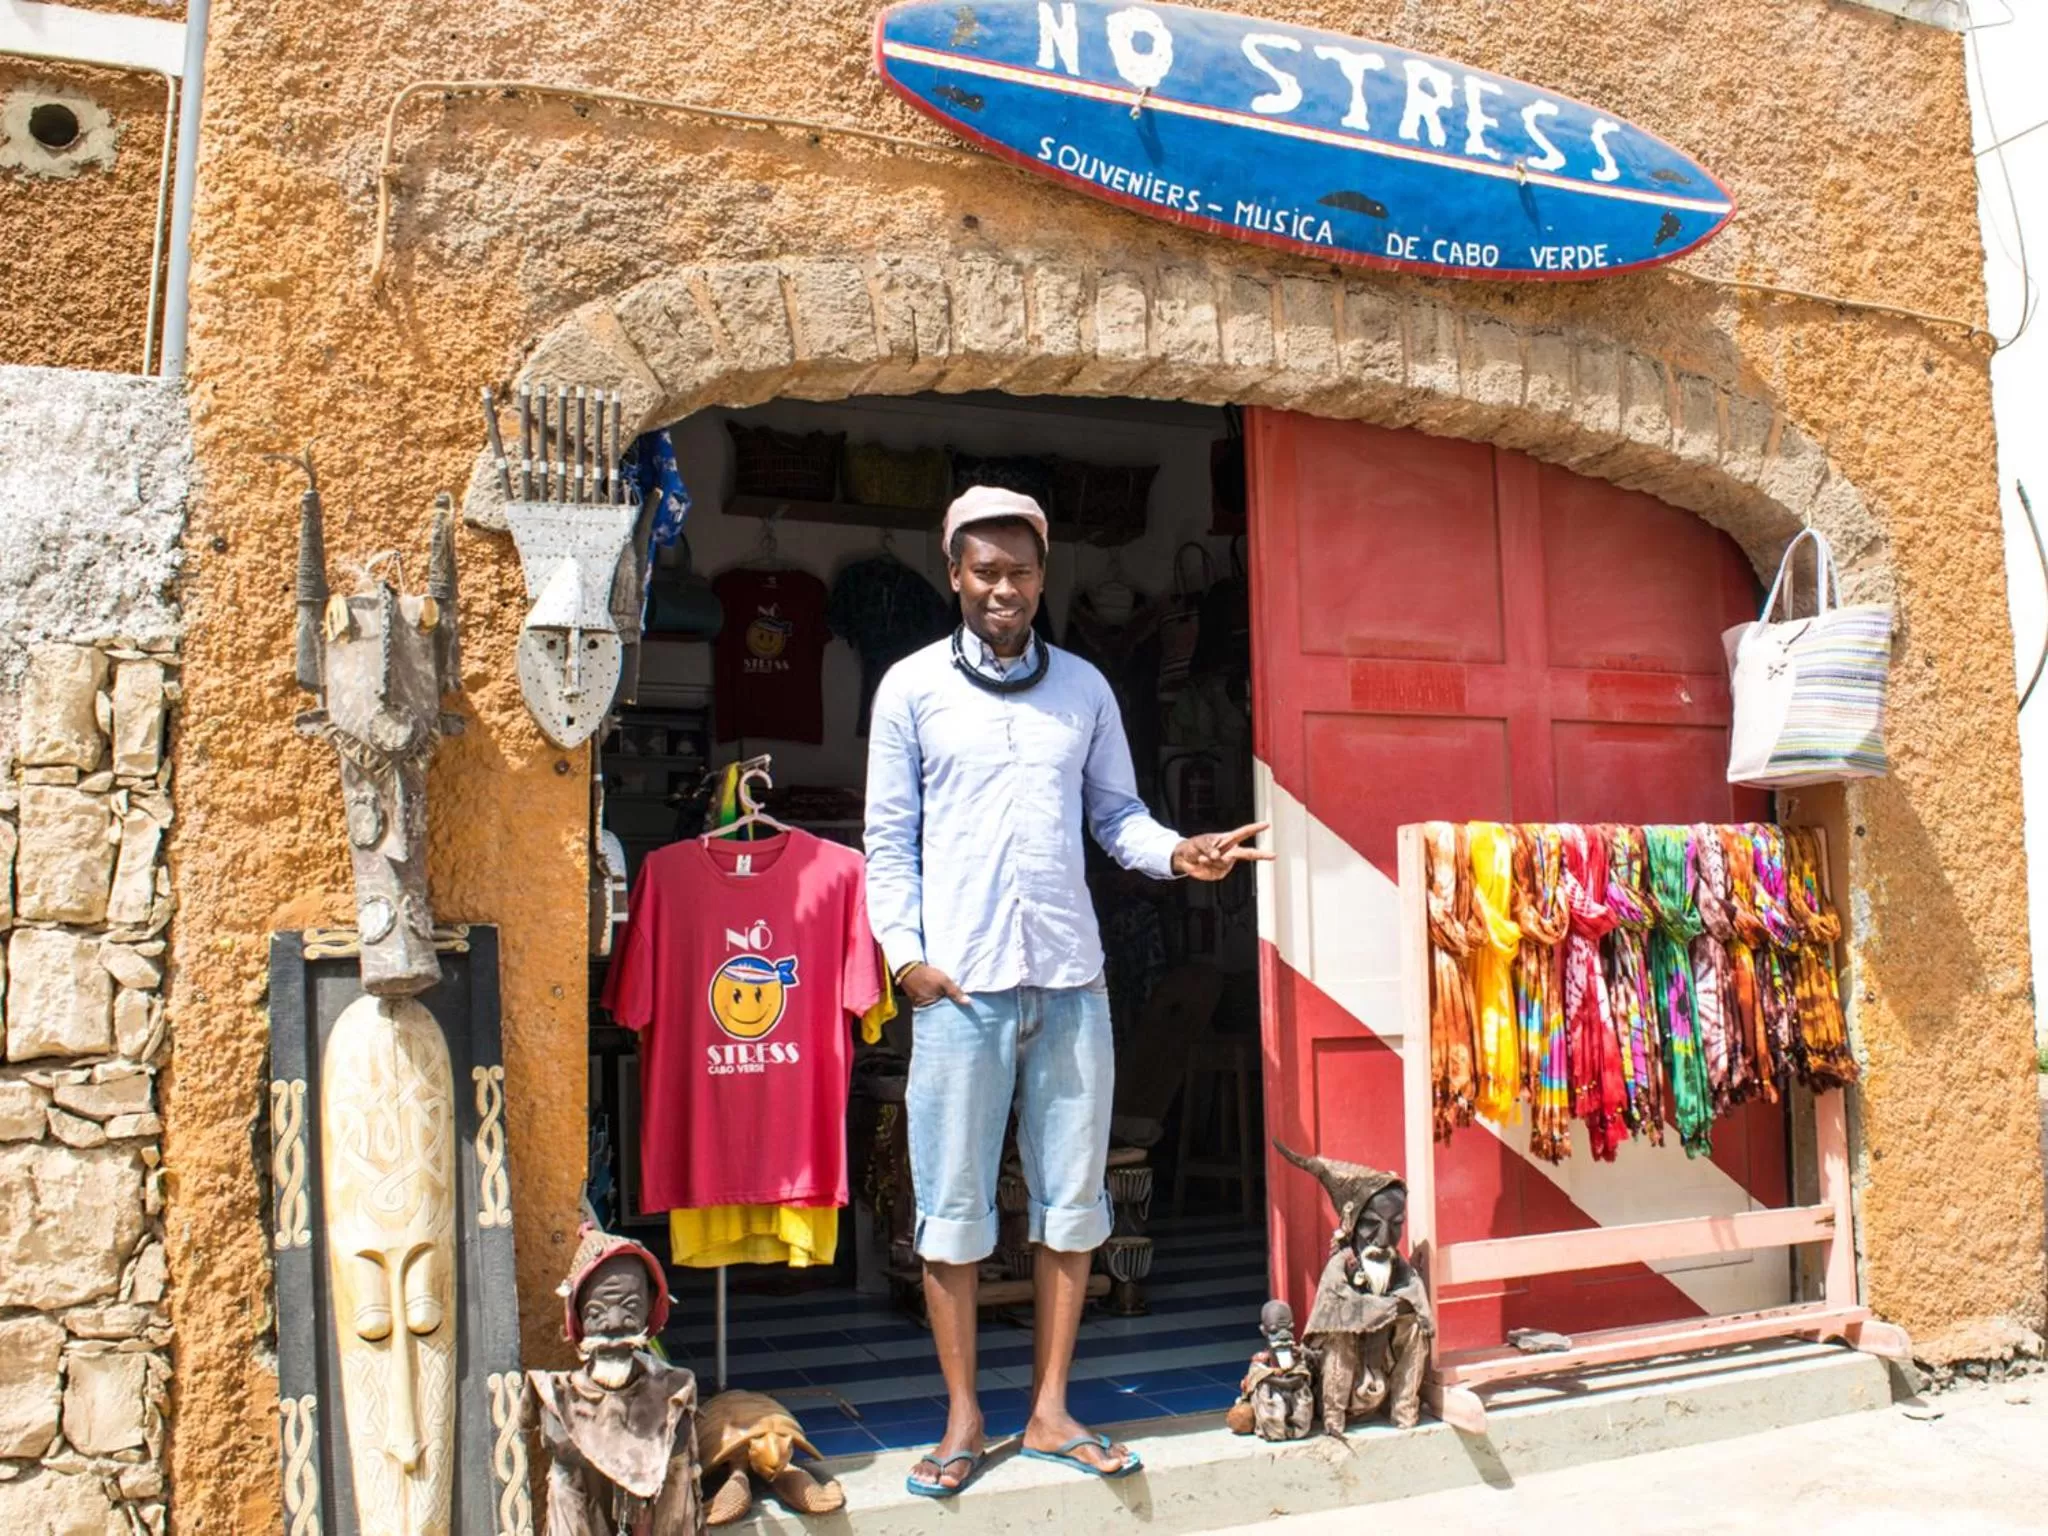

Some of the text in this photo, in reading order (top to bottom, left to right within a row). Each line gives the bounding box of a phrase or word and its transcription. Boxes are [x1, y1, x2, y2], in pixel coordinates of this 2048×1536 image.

[1036, 2, 1622, 182] NO STRESS
[1432, 239, 1499, 267] CABO
[726, 919, 773, 951] NÔ
[706, 1042, 800, 1065] STRESS
[708, 1063, 765, 1074] CABO VERDE
